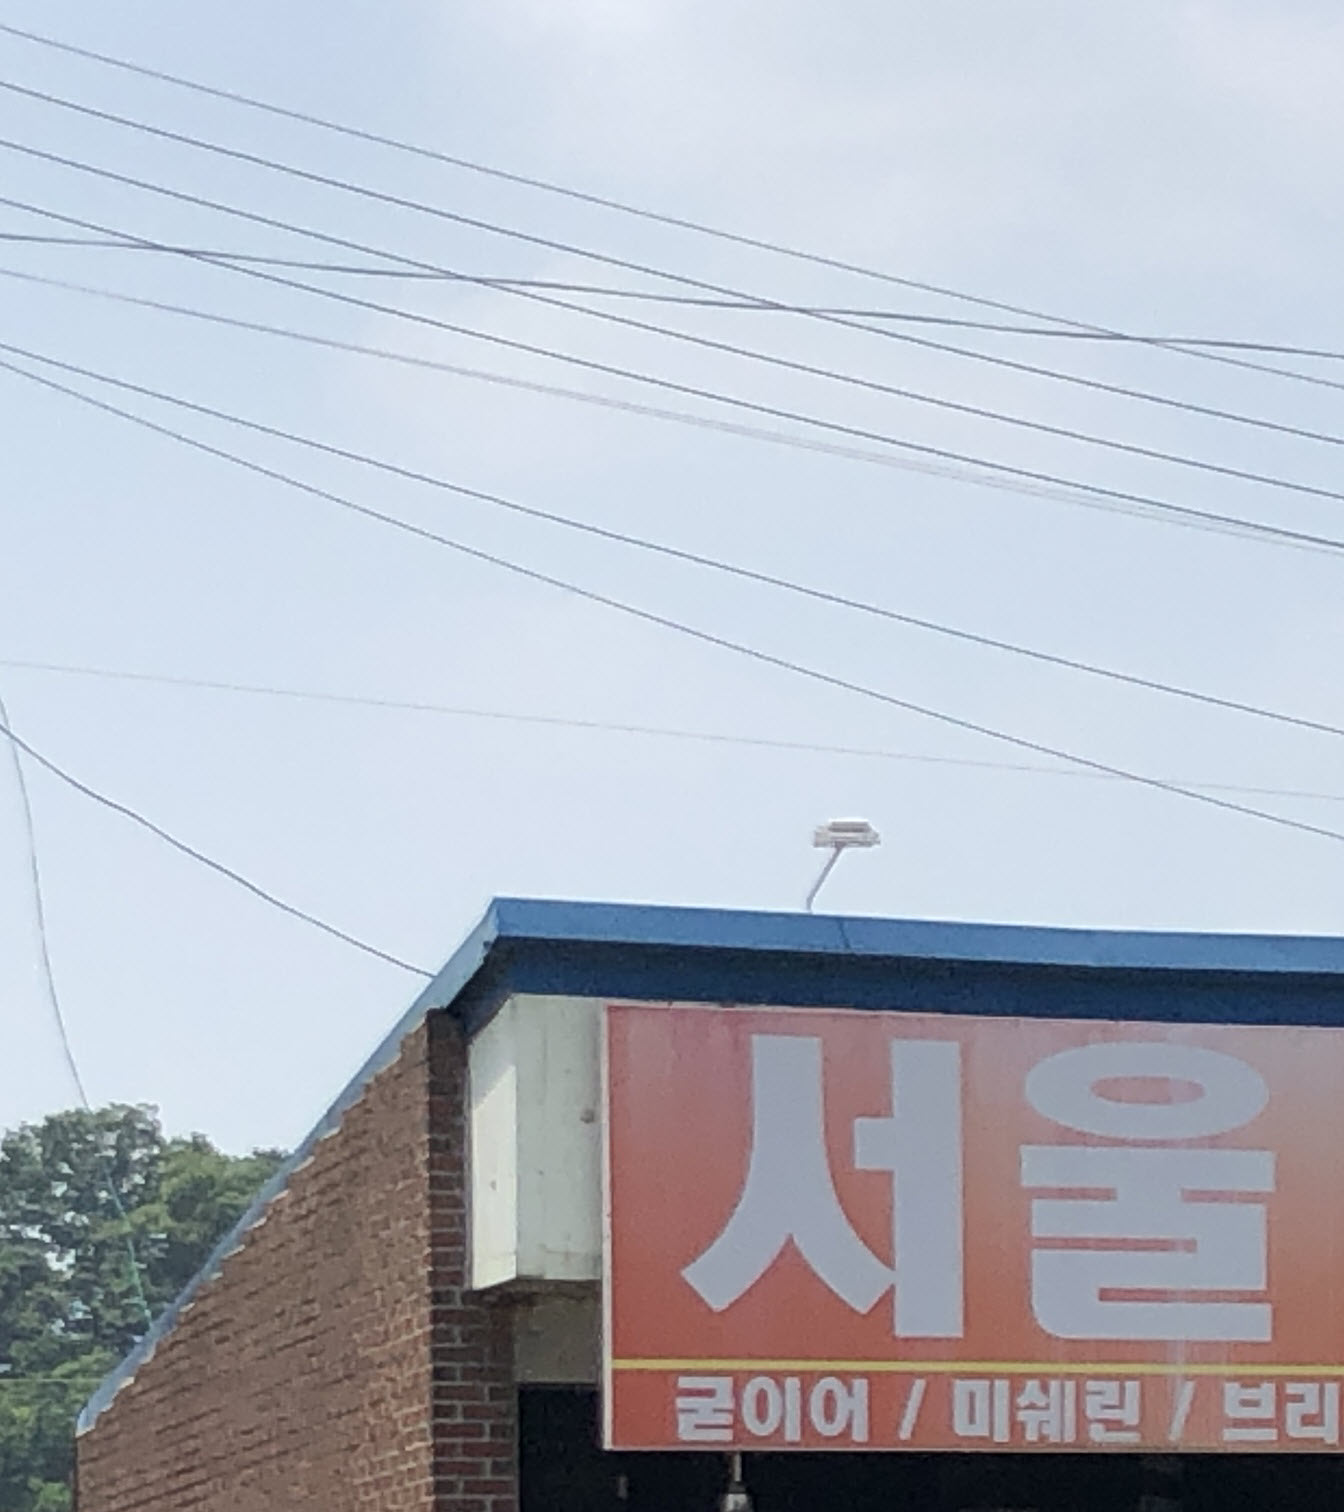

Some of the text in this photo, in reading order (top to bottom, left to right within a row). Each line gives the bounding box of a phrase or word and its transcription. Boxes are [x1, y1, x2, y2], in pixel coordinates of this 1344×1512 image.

[681, 1034, 1276, 1342] 서울
[676, 1376, 869, 1442] 굳이어
[952, 1379, 1140, 1443] 미쉐린
